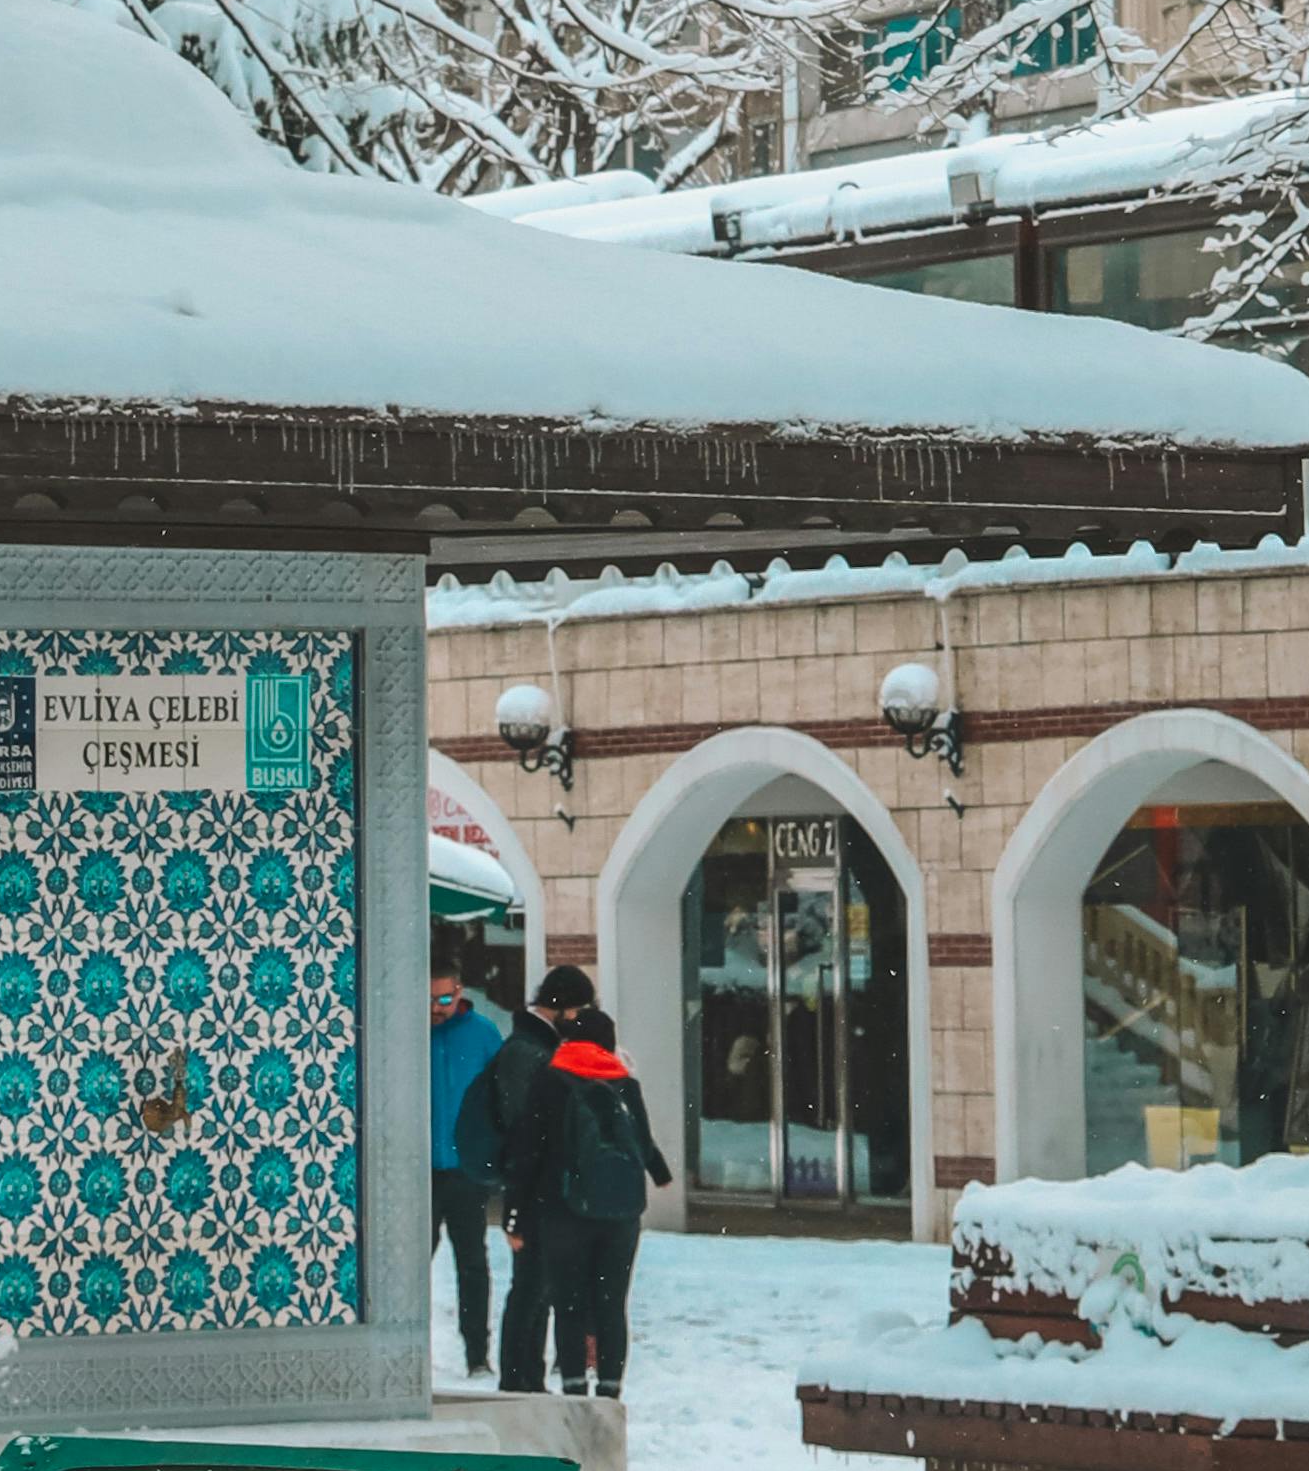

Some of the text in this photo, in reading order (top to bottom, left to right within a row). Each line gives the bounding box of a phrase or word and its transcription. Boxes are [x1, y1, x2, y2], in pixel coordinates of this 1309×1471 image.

[43, 688, 240, 729] EVLİYA ÇELEBİ
[82, 734, 200, 775] ÇEŞMESİ
[252, 765, 304, 787] BUSKİ
